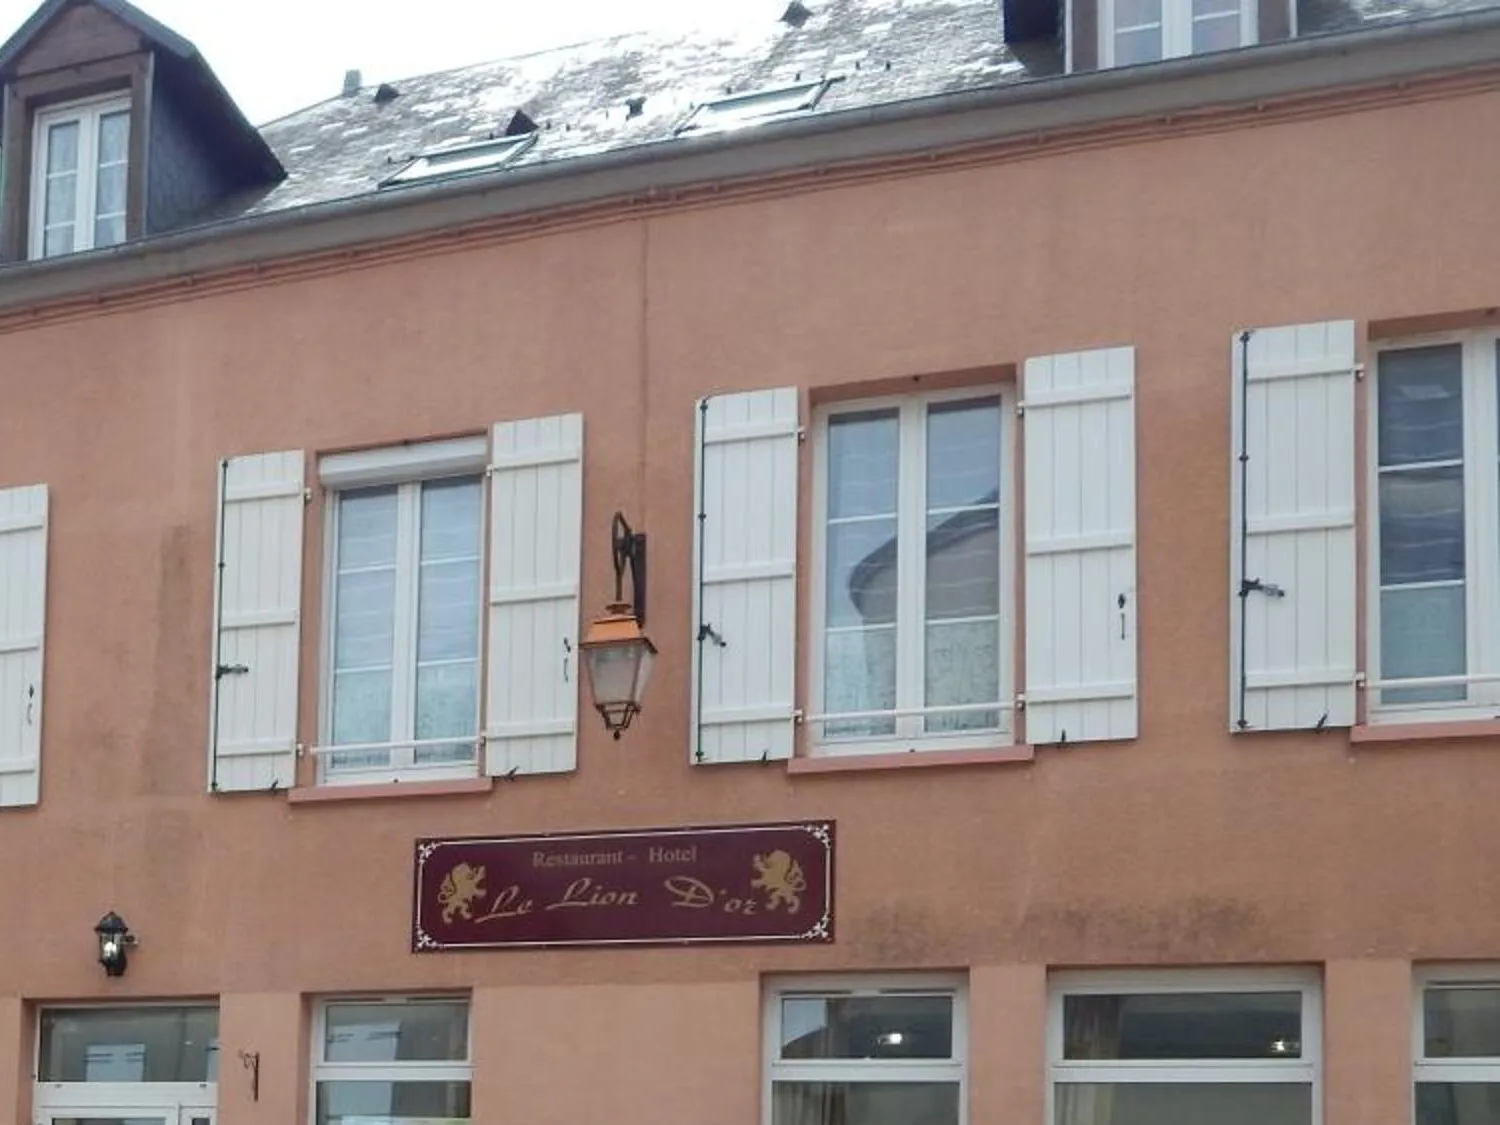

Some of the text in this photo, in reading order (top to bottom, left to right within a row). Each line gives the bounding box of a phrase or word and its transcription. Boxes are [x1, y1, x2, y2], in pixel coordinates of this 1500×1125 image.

[532, 851, 624, 868] Restaurant
[649, 846, 698, 863] Hotel
[474, 884, 534, 924] Le
[545, 876, 639, 911] Lion
